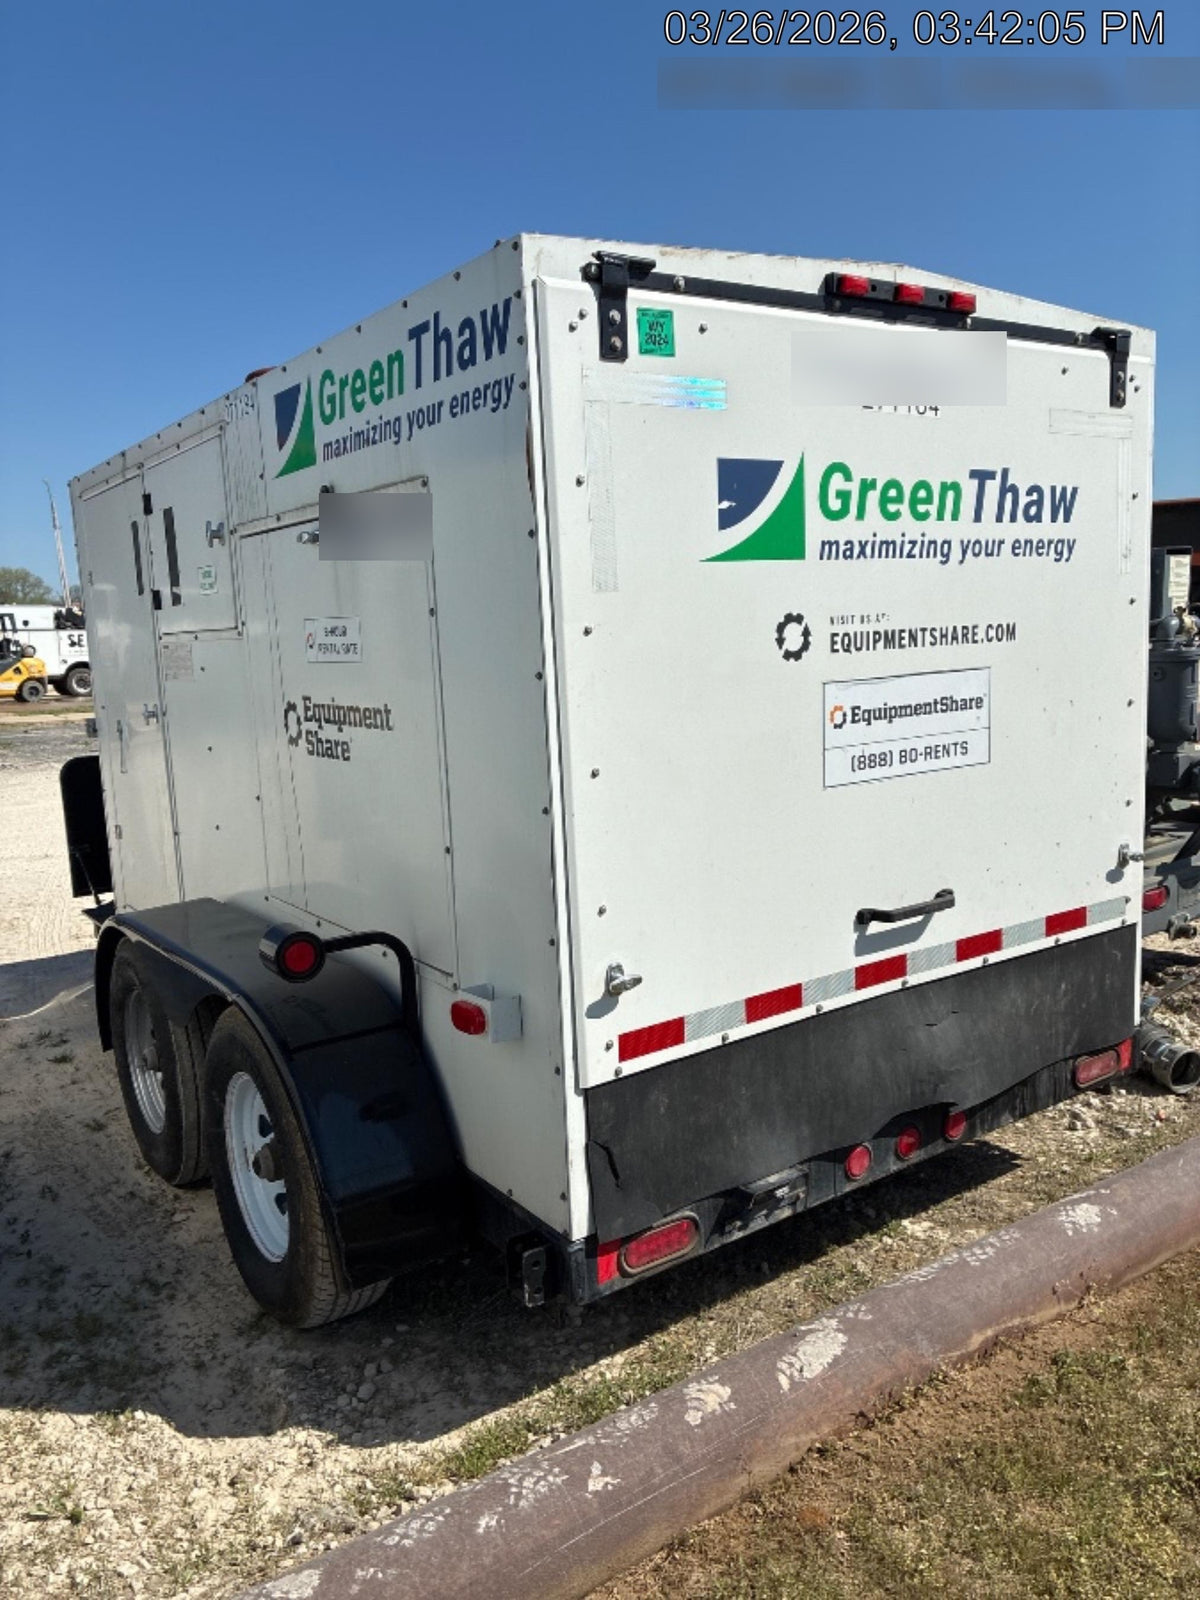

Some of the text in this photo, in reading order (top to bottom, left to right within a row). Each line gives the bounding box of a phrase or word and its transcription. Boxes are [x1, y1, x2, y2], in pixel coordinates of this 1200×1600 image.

[319, 297, 512, 425] GreenThaw
[322, 373, 516, 462] maximizing your energy
[818, 461, 1079, 523] GreenThaw
[819, 532, 1077, 565] maximizing your energy
[830, 614, 856, 626] VISIT
[830, 622, 1017, 654] EQUIPMENTSHARE.COM
[302, 695, 393, 732] Equipment
[850, 696, 984, 726] EquipmentShare
[305, 730, 351, 761] Share
[851, 751, 894, 772] (888)
